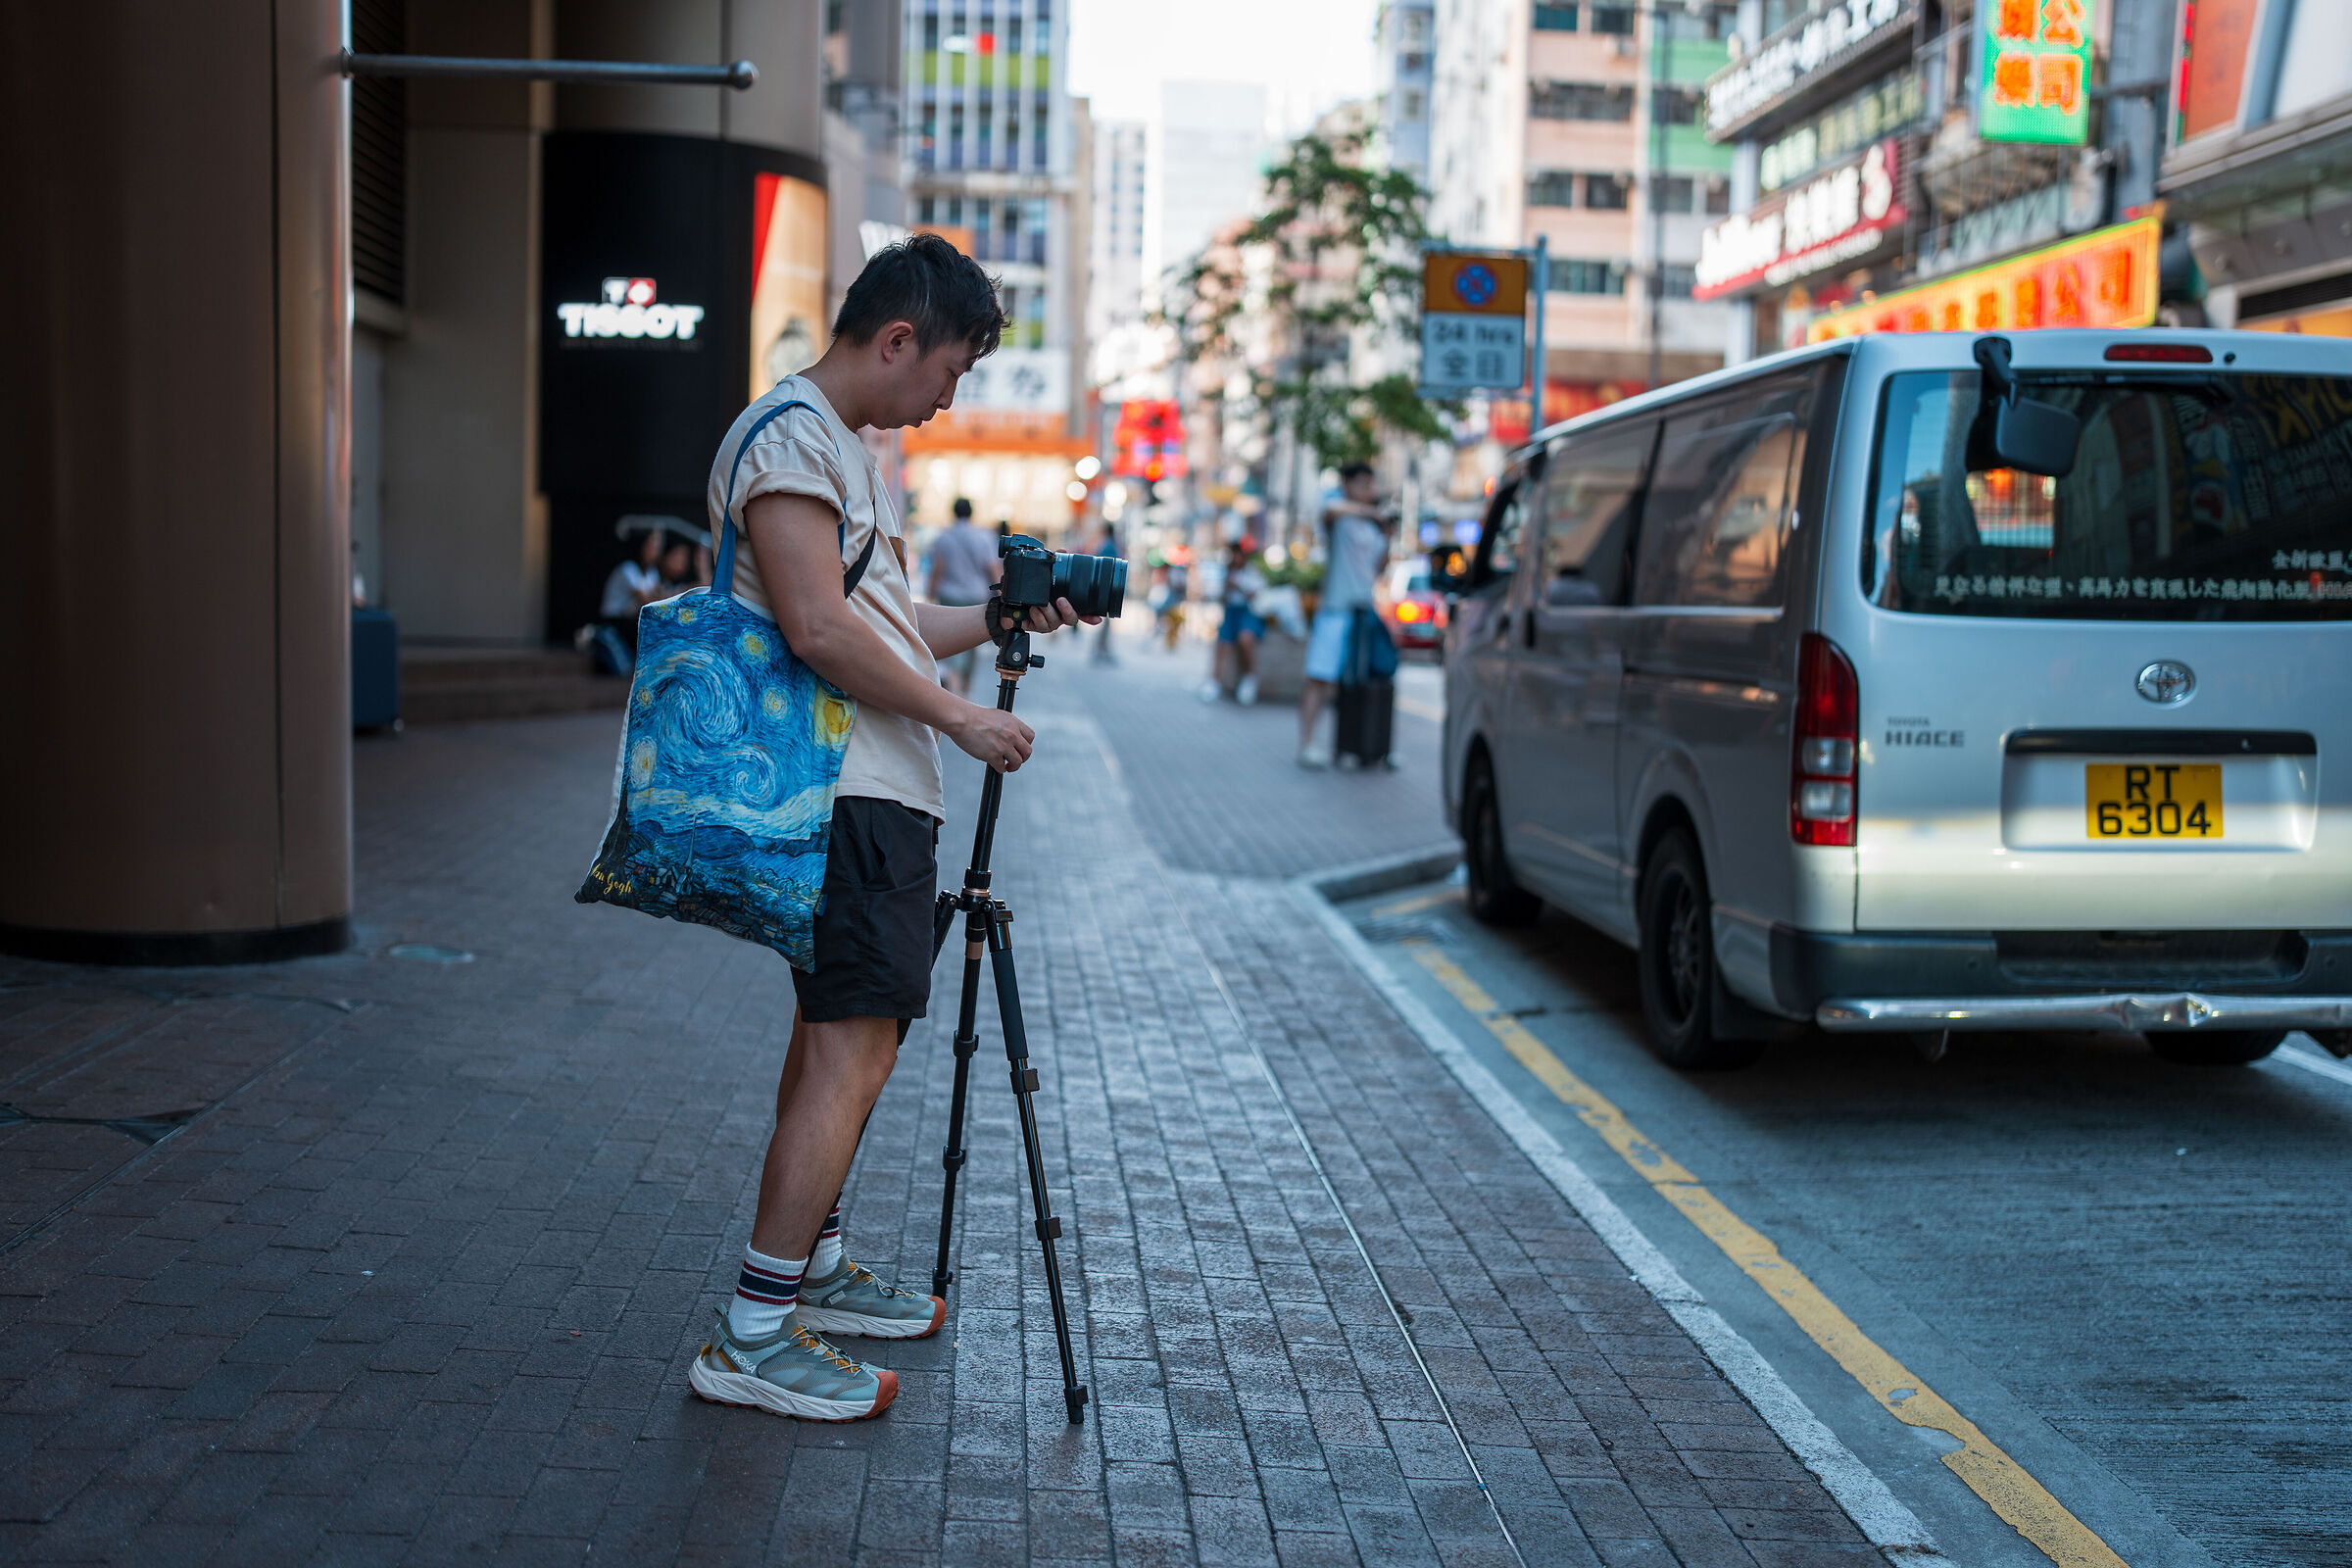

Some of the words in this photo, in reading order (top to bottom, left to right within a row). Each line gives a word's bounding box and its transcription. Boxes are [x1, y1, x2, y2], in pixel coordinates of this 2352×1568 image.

[557, 302, 705, 340] TISSOT
[1886, 716, 1931, 727] TOYOTA
[1885, 731, 1965, 748] HIACE
[2125, 764, 2180, 800] RT
[2096, 801, 2212, 836] 6304
[603, 871, 632, 895] Gogh
[730, 1349, 757, 1374] HOKA
